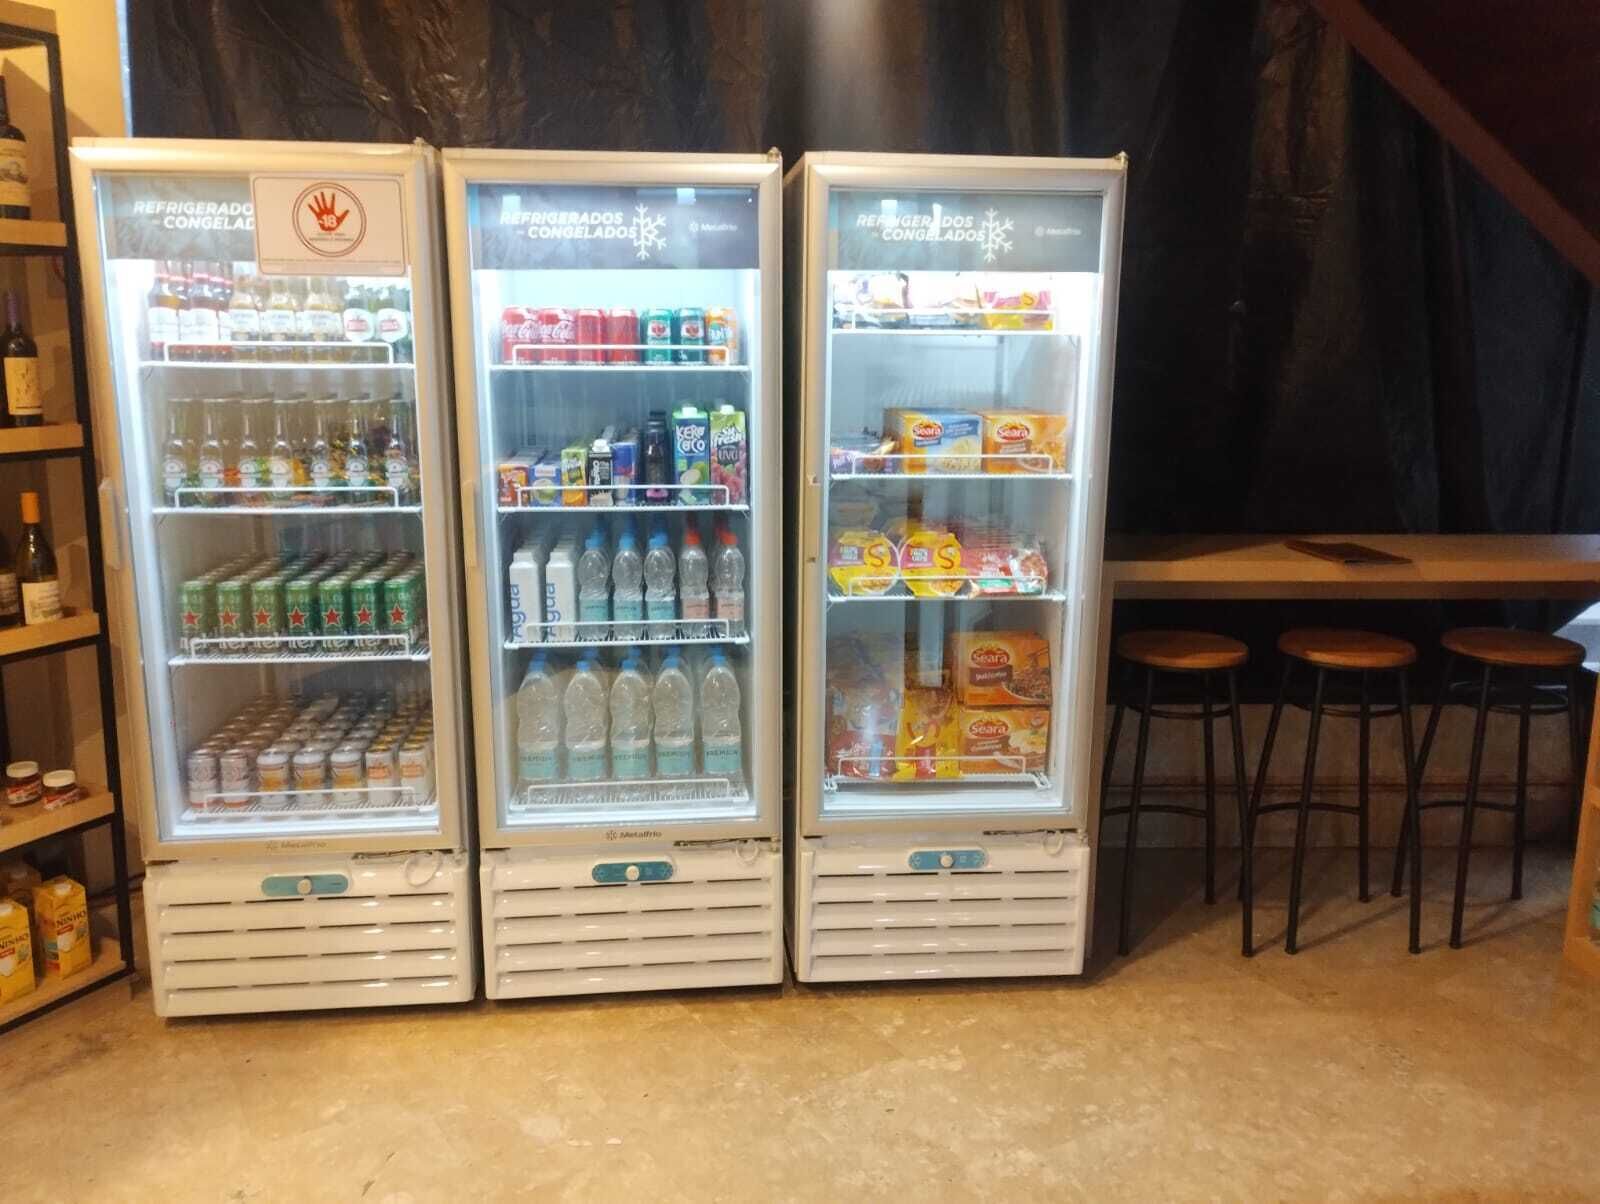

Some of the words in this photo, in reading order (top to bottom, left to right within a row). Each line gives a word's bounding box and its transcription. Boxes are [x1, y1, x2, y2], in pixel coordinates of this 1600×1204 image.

[499, 211, 624, 226] REFRIGERADOS
[856, 213, 975, 229] REFIGERDOS
[527, 225, 638, 240] CONGELADOS
[881, 228, 986, 242] CONGELADOS
[912, 424, 943, 439] Seara
[997, 427, 1029, 441] Seara
[974, 650, 1008, 665] Seara
[971, 721, 1006, 736] Seara
[55, 910, 87, 928] NINHO
